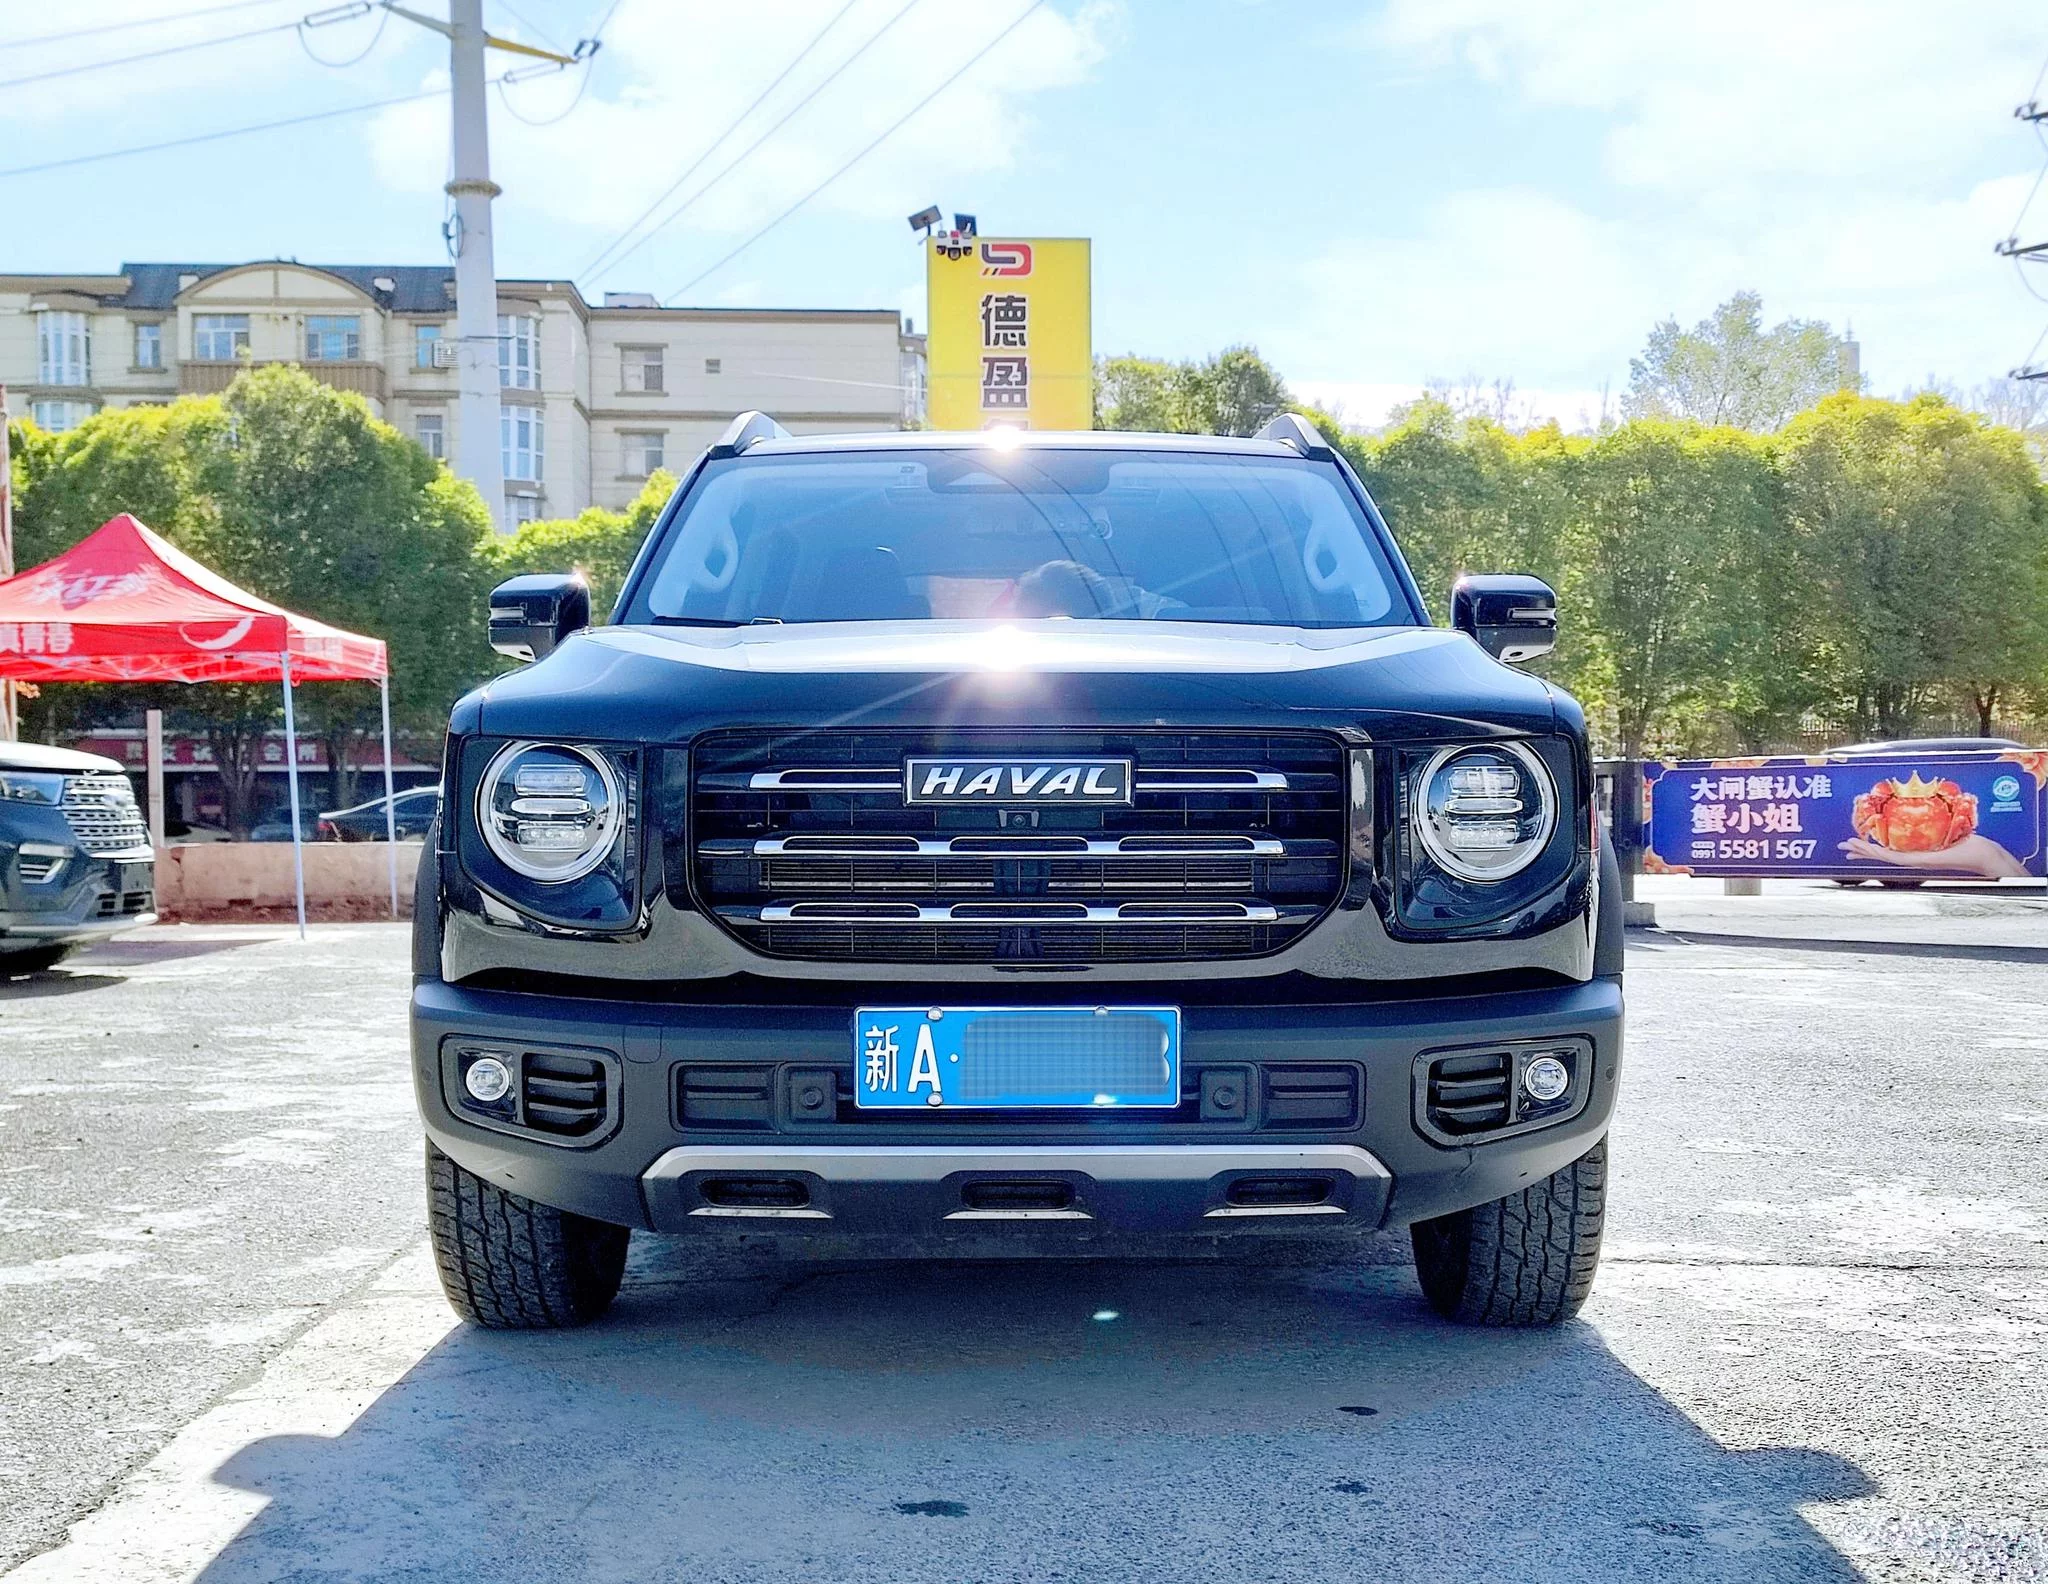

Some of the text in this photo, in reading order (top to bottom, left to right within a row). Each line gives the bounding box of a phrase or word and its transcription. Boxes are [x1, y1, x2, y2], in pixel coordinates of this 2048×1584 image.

[981, 294, 1028, 430] 德盈
[920, 767, 1118, 795] HAVAL
[1690, 774, 1833, 801] 大闸蟹认准
[1690, 803, 1803, 834] 蟹小姐
[1719, 839, 1770, 859] 5581
[1775, 839, 1818, 859] 567
